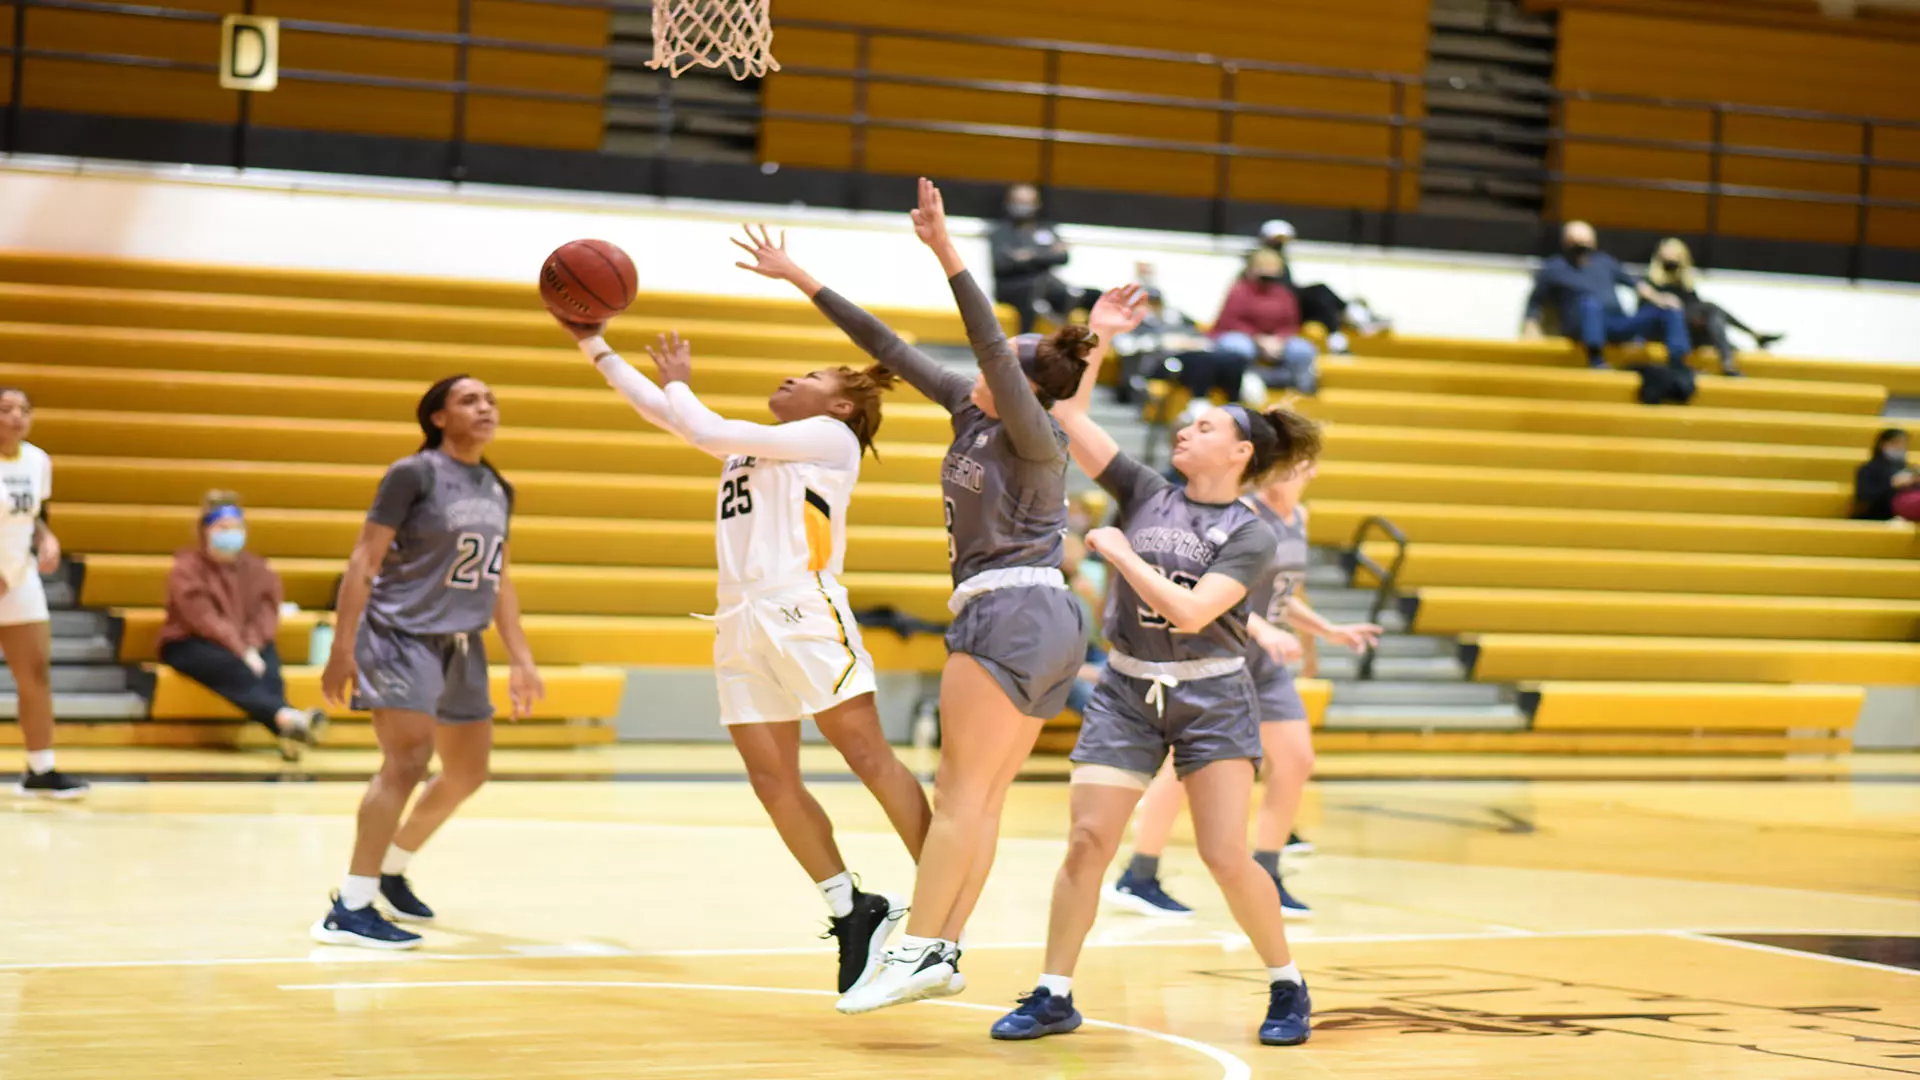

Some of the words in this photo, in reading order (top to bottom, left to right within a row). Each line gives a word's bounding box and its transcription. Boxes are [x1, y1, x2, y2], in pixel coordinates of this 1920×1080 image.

[231, 24, 267, 78] D
[721, 474, 753, 520] 25
[444, 532, 504, 593] 24
